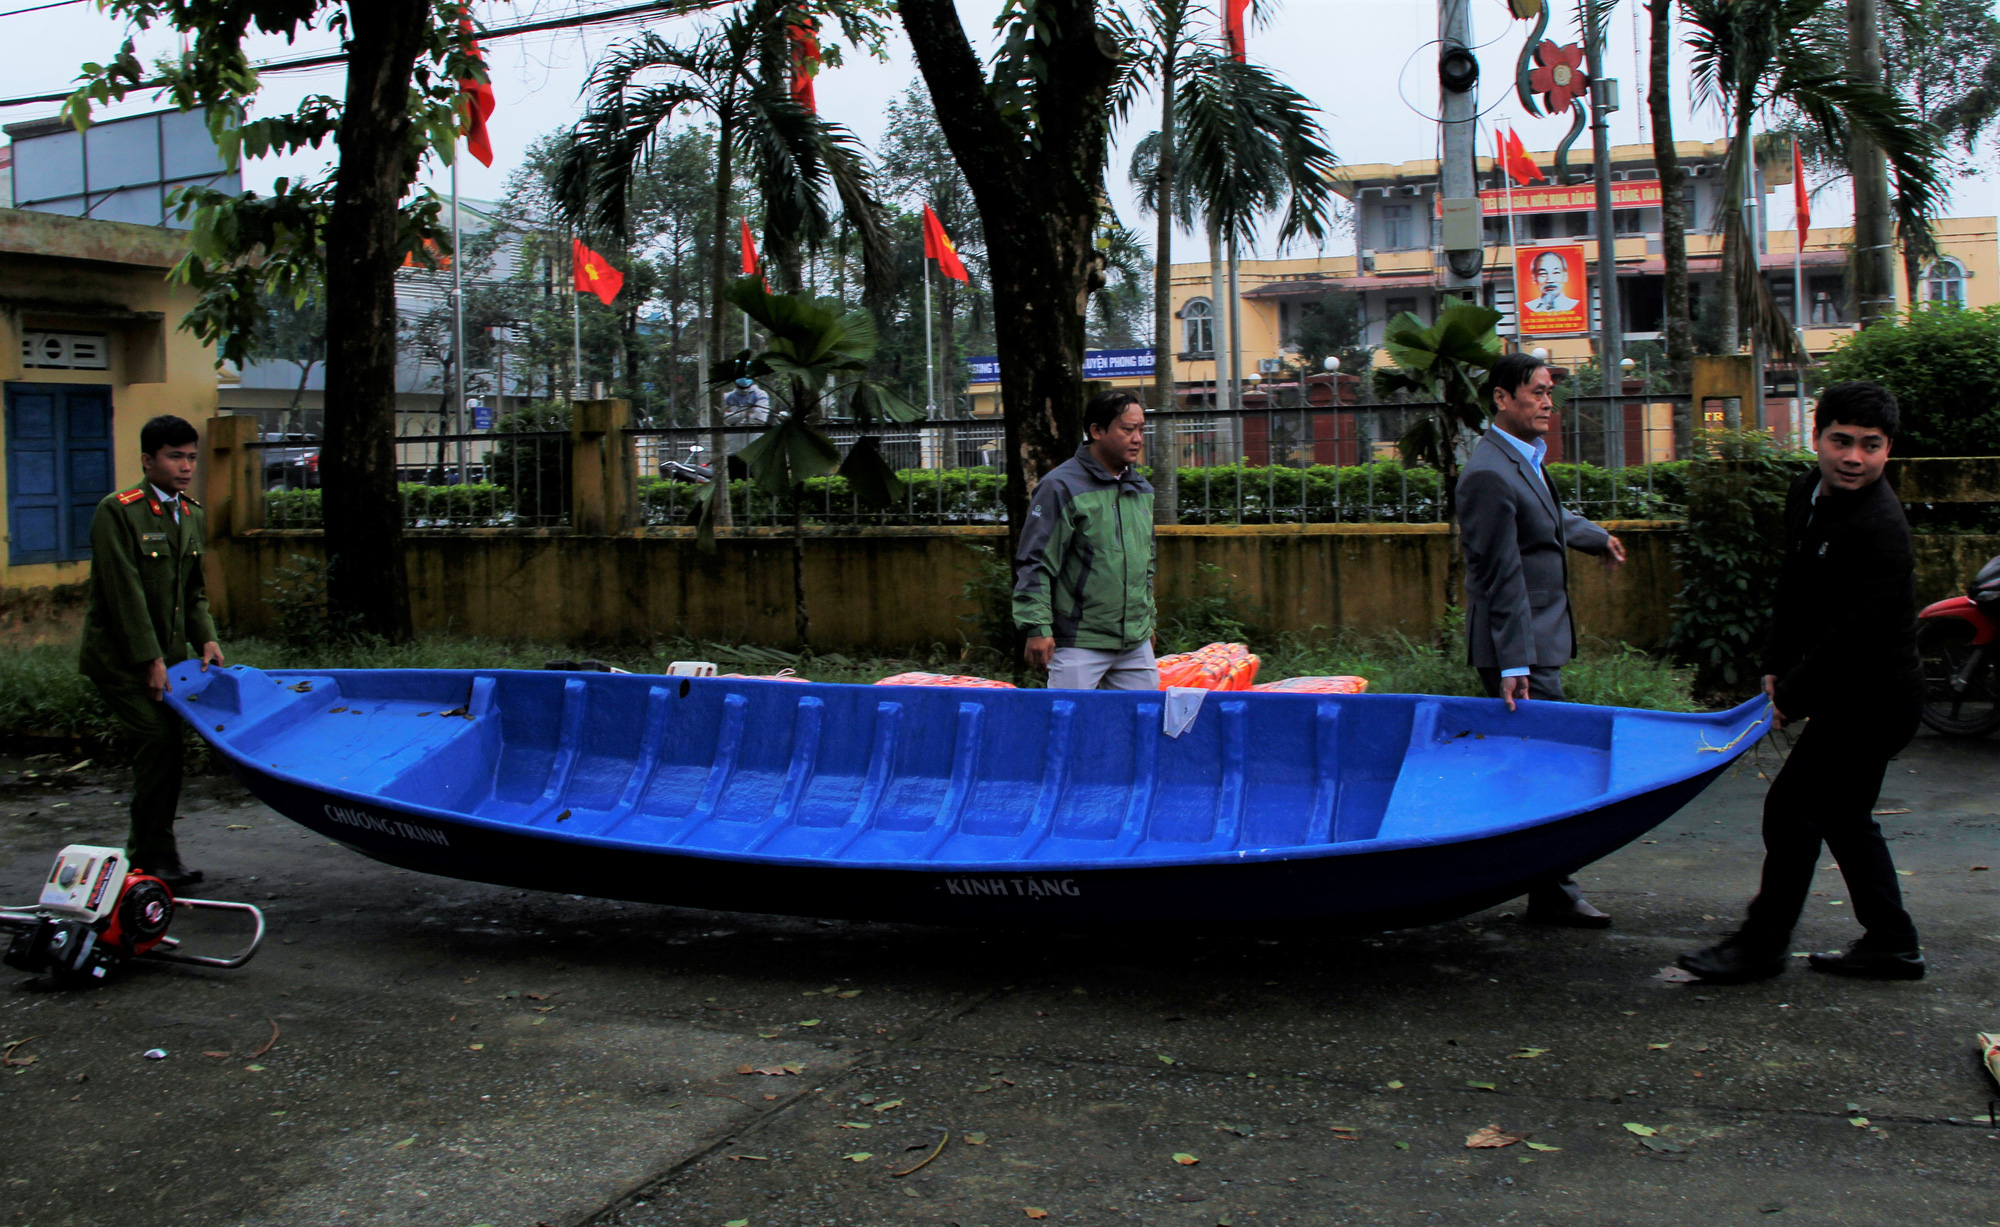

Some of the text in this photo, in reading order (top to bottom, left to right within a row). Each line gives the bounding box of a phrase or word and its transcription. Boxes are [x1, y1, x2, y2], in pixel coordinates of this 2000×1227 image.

[1082, 355, 1108, 371] UYỆN
[1109, 356, 1137, 368] PHONG
[324, 804, 450, 846] CHƯƠNG TRÌNH
[945, 874, 1009, 896] KÍNH
[1010, 876, 1081, 900] TẶNG
